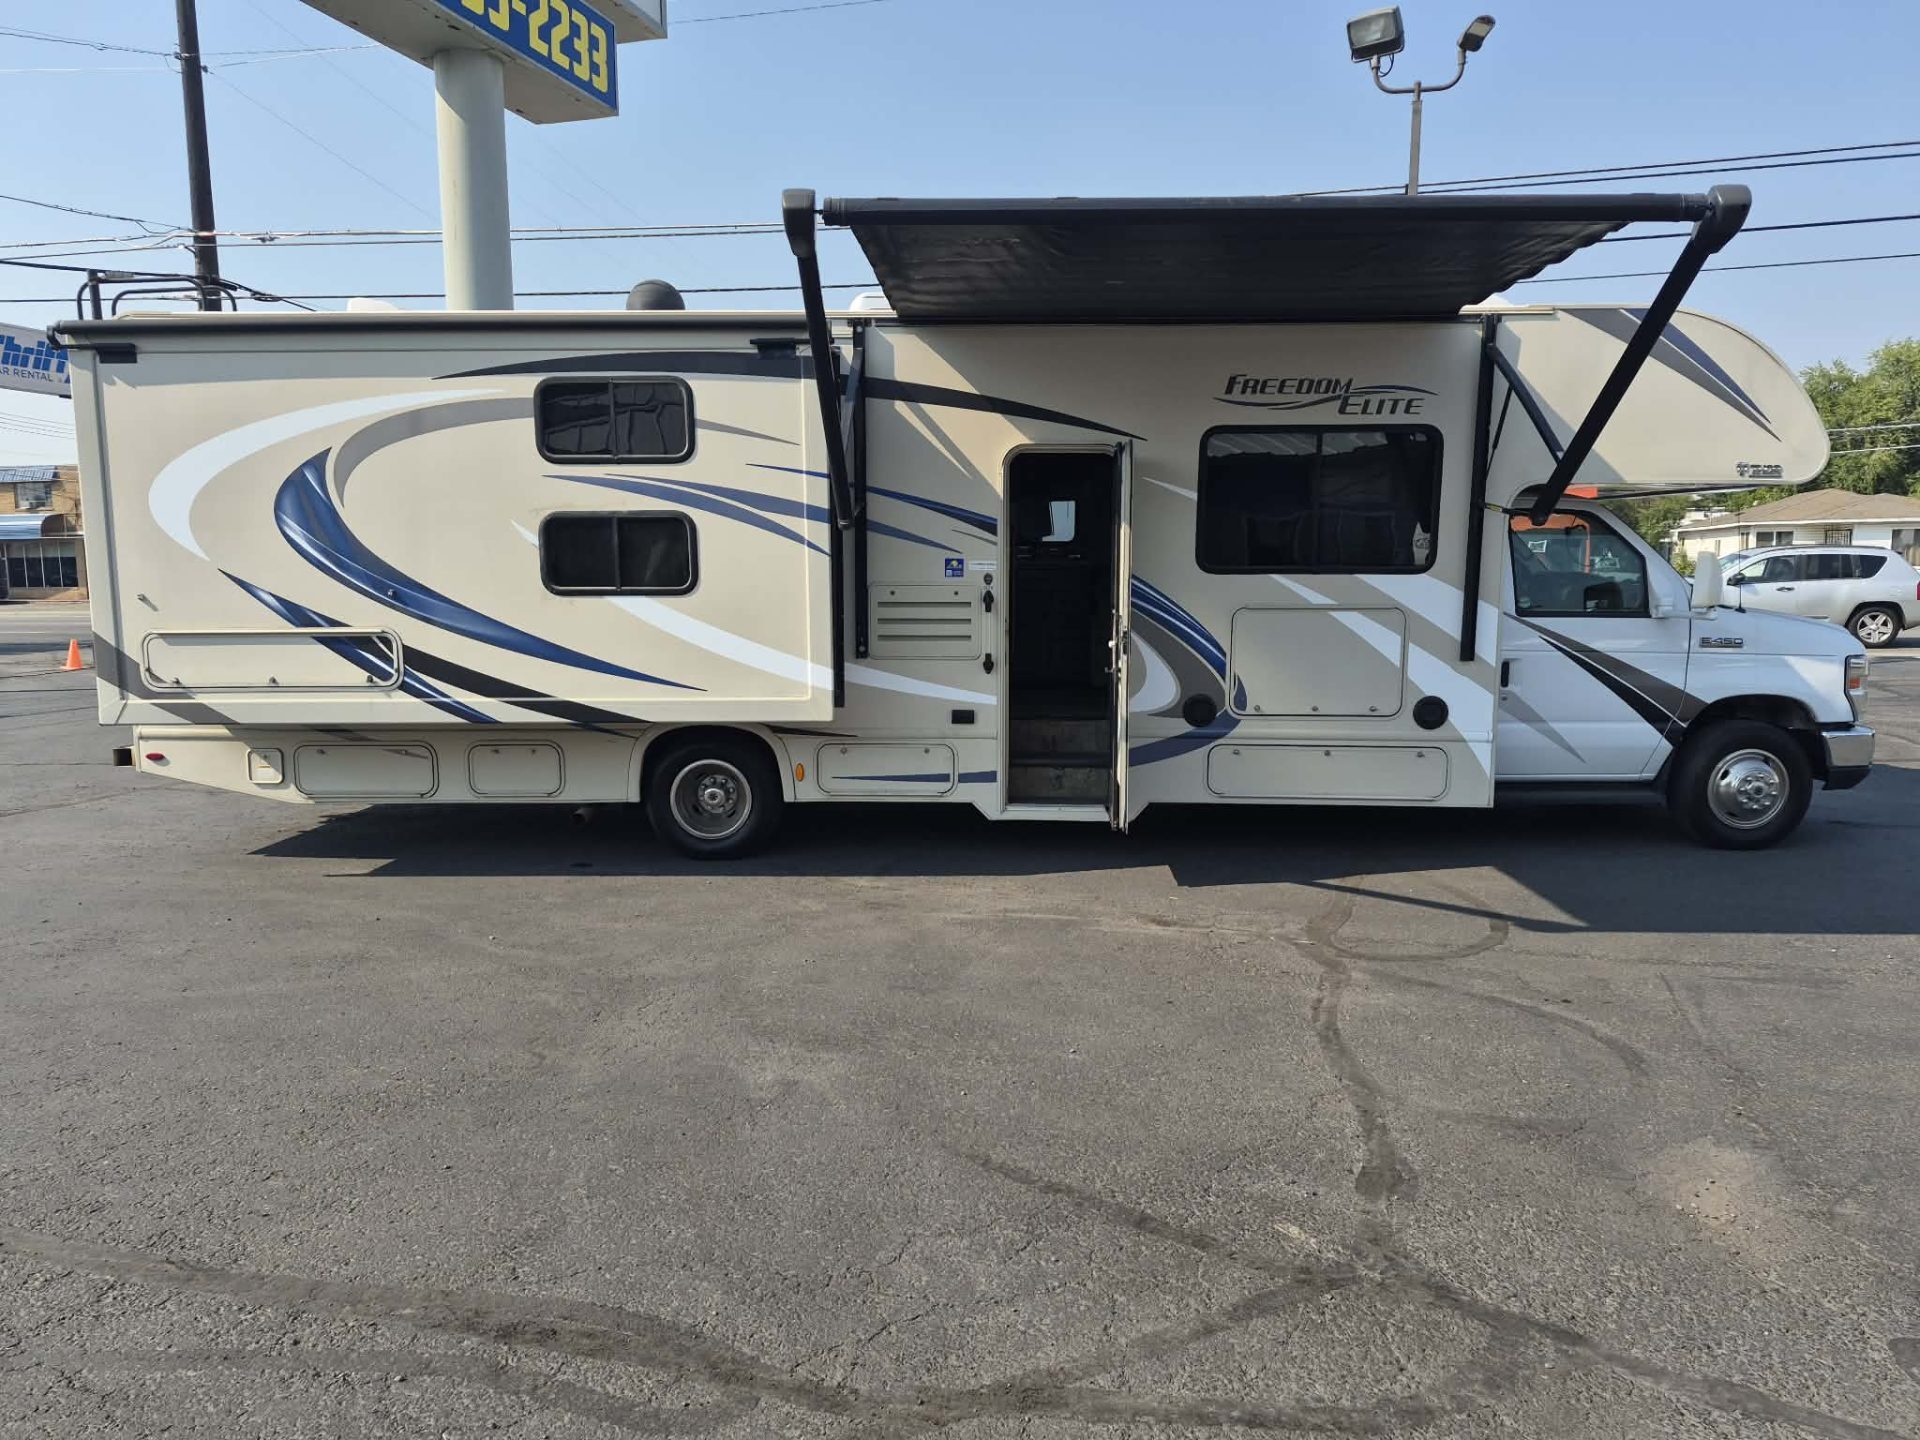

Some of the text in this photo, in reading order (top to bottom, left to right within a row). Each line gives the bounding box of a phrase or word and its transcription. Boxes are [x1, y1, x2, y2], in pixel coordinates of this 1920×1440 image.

[13, 368, 54, 382] RENTAL
[1224, 374, 1354, 396] FREEDOM
[1338, 396, 1425, 415] ELITE
